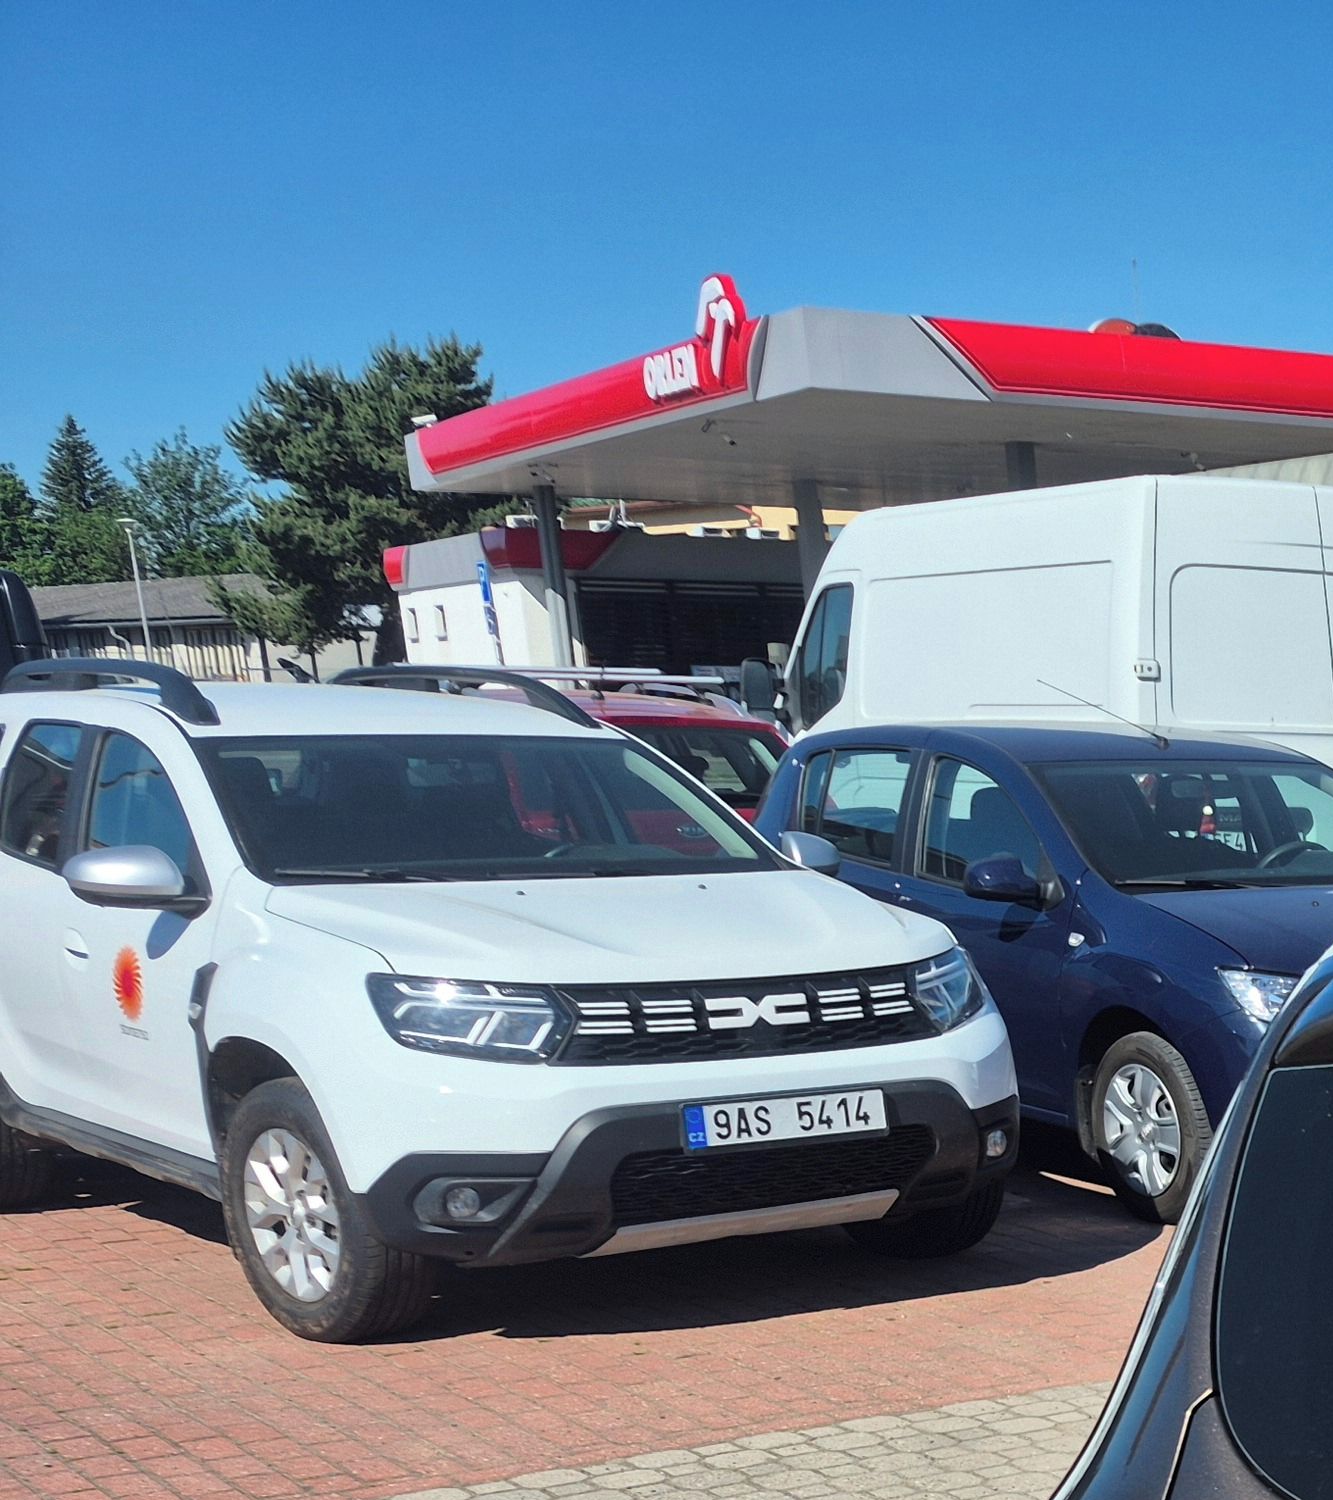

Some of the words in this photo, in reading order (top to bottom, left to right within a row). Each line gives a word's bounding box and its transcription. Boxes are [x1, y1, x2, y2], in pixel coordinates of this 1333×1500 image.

[643, 343, 700, 400] ORLEN
[688, 1132, 705, 1142] CZ
[713, 1105, 772, 1140] 9AS
[796, 1096, 870, 1131] 5414
